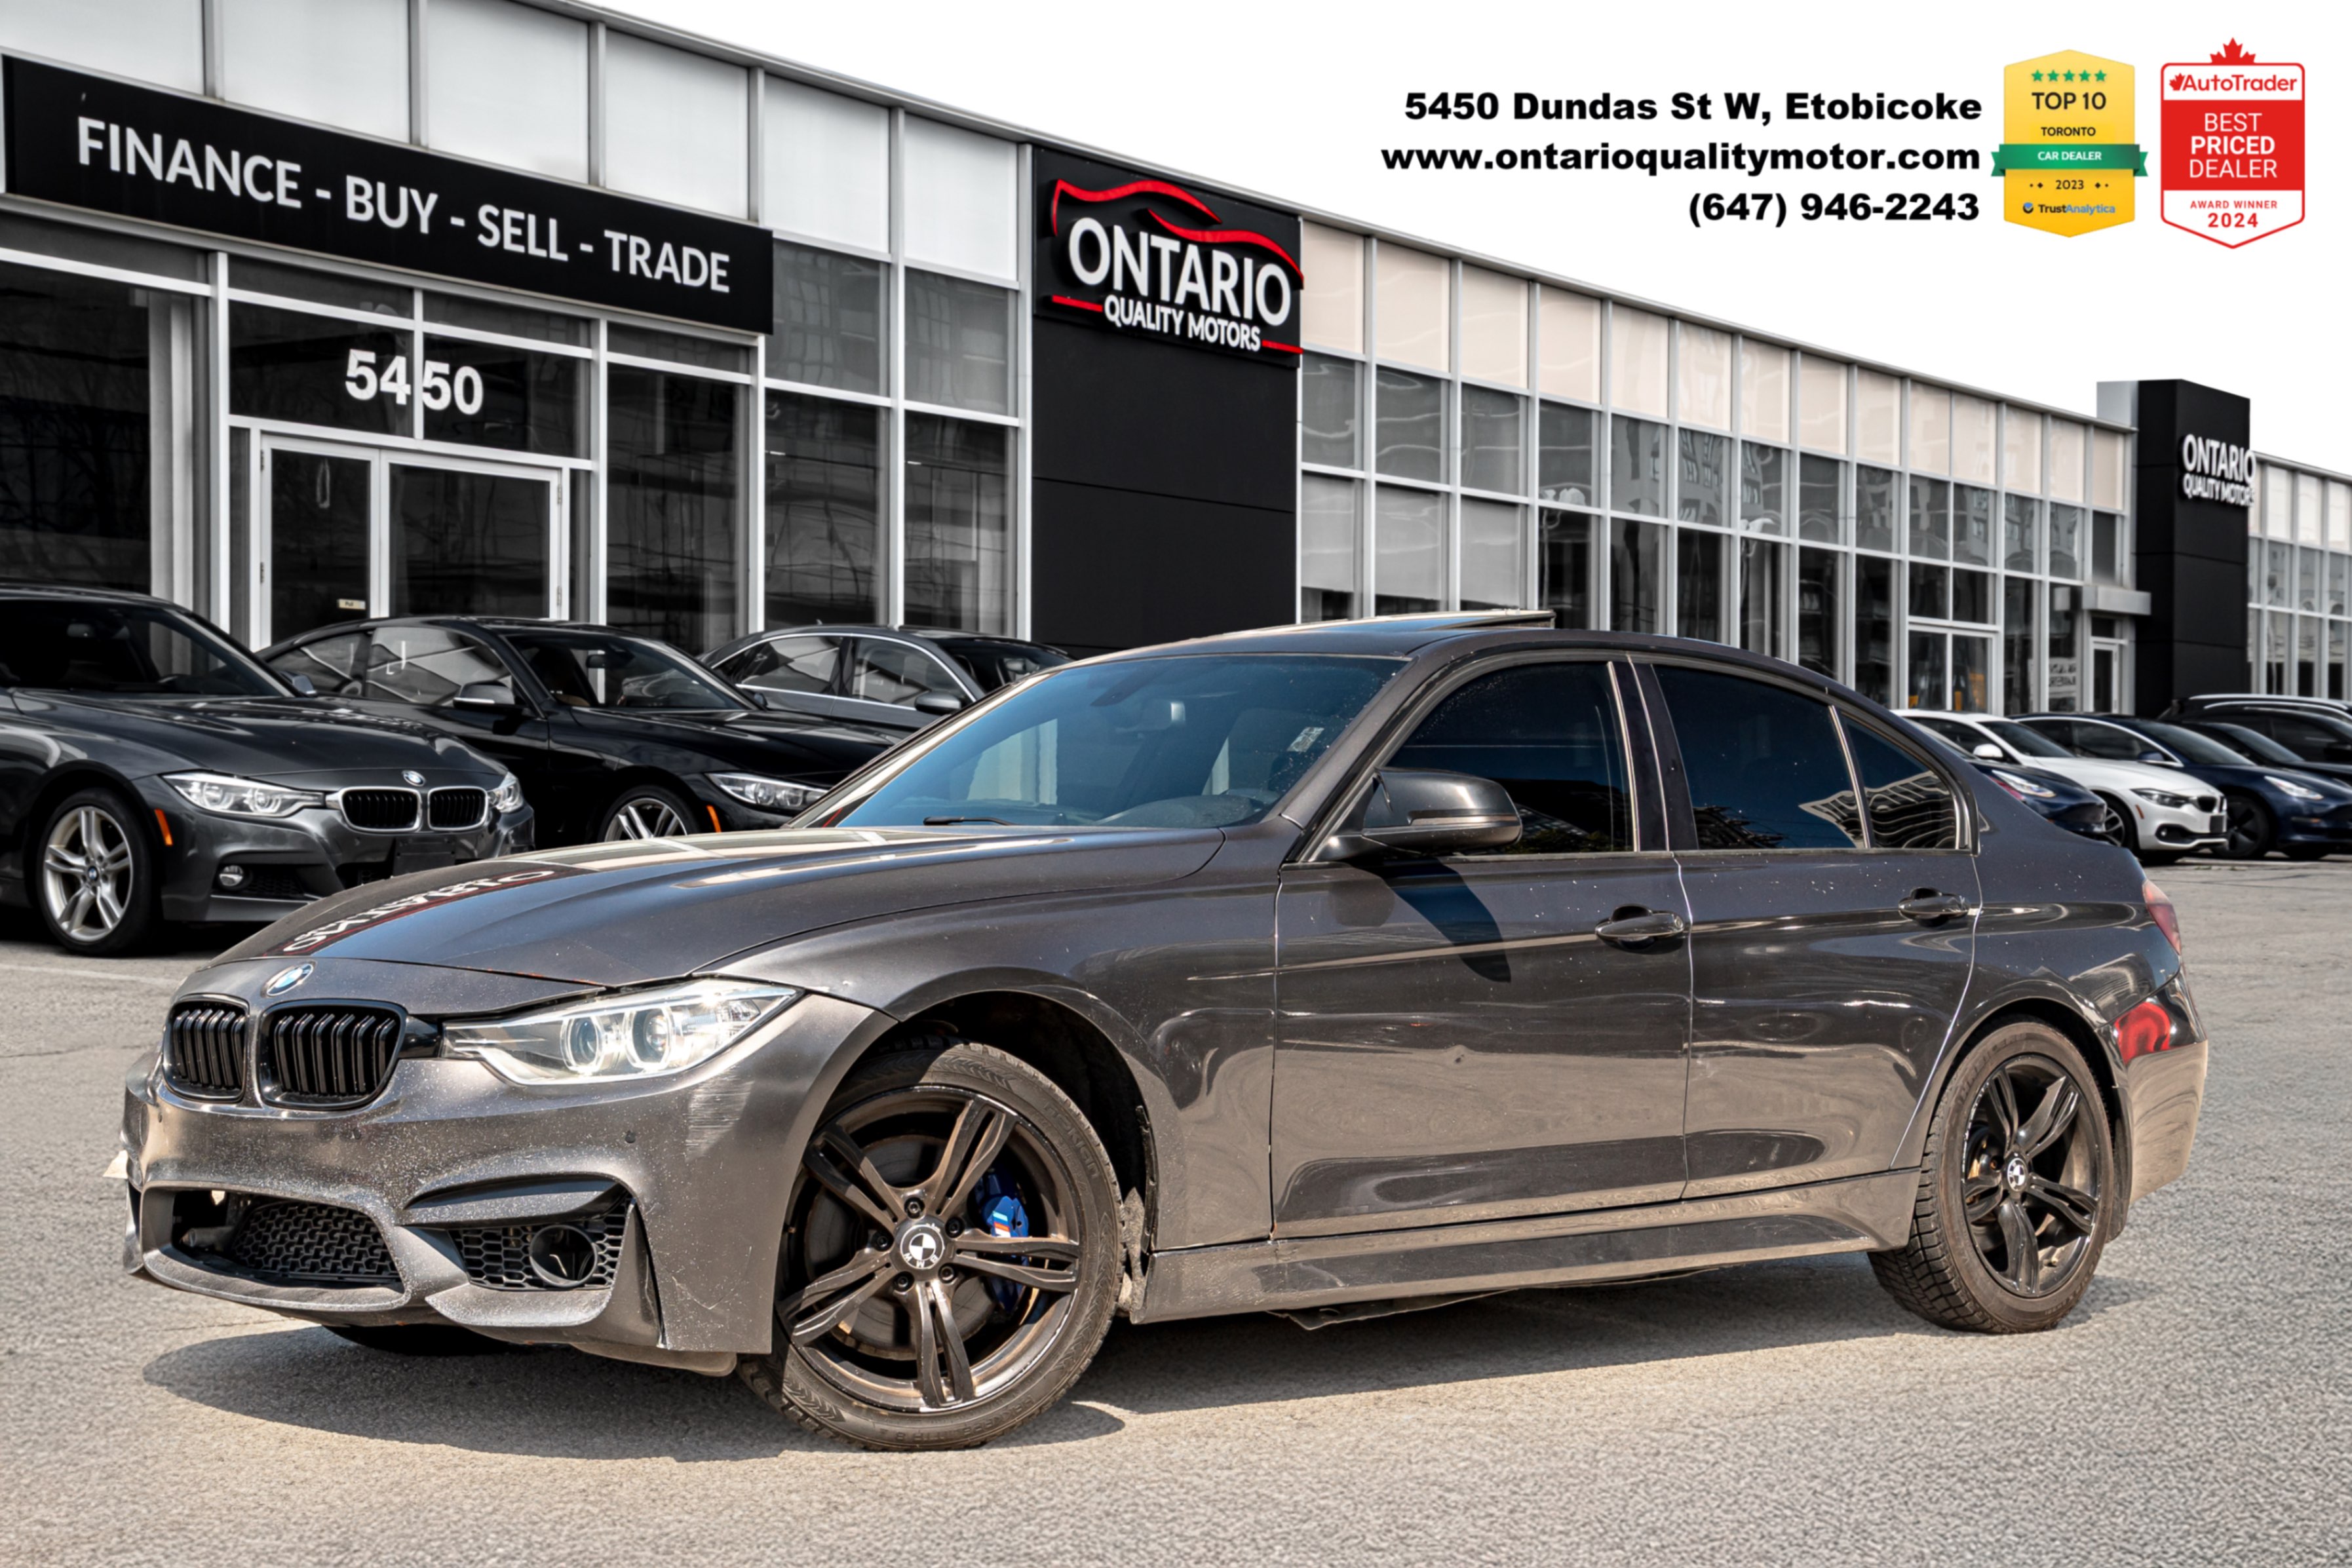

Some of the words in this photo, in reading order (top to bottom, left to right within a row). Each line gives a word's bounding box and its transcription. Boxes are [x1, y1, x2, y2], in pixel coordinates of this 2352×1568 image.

[78, 116, 302, 209] FINANCE
[345, 174, 438, 235] BUY
[477, 204, 568, 261] SELL
[604, 229, 730, 293] TRADE
[1069, 217, 1291, 326] ONTARIO
[1104, 295, 1185, 335] QUALITY
[1187, 312, 1261, 351] MOTORS
[345, 348, 484, 415] 5450
[2183, 434, 2256, 485] ONTARIO
[2183, 473, 2220, 500] QUALITY
[2221, 481, 2254, 507] MOTORS
